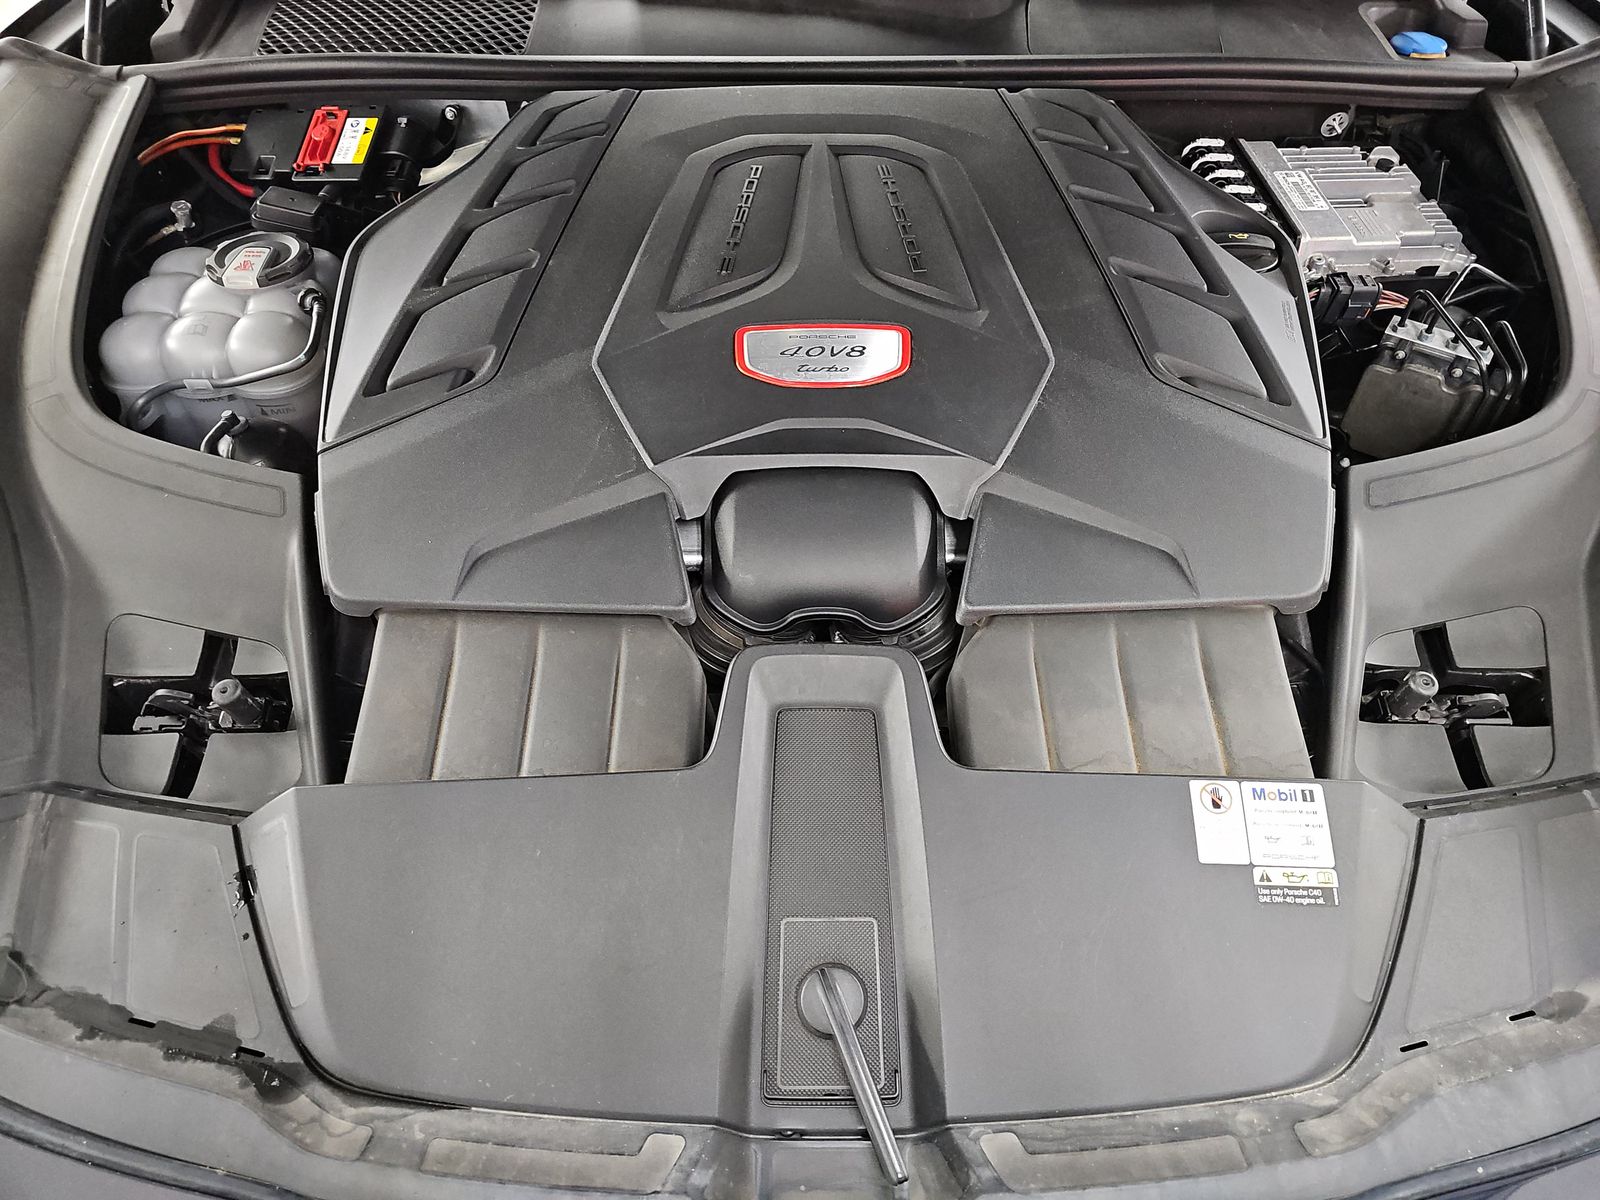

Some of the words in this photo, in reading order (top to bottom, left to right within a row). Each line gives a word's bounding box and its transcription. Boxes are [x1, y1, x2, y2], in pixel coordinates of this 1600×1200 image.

[717, 164, 763, 275] PORSCHE
[877, 164, 928, 273] PORSCHE
[797, 364, 850, 373] turbo
[1252, 787, 1297, 802] Mobil
[1301, 789, 1315, 802] 1
[1271, 888, 1283, 897] only
[1284, 888, 1308, 896] Porsche
[1258, 895, 1272, 903] SAE
